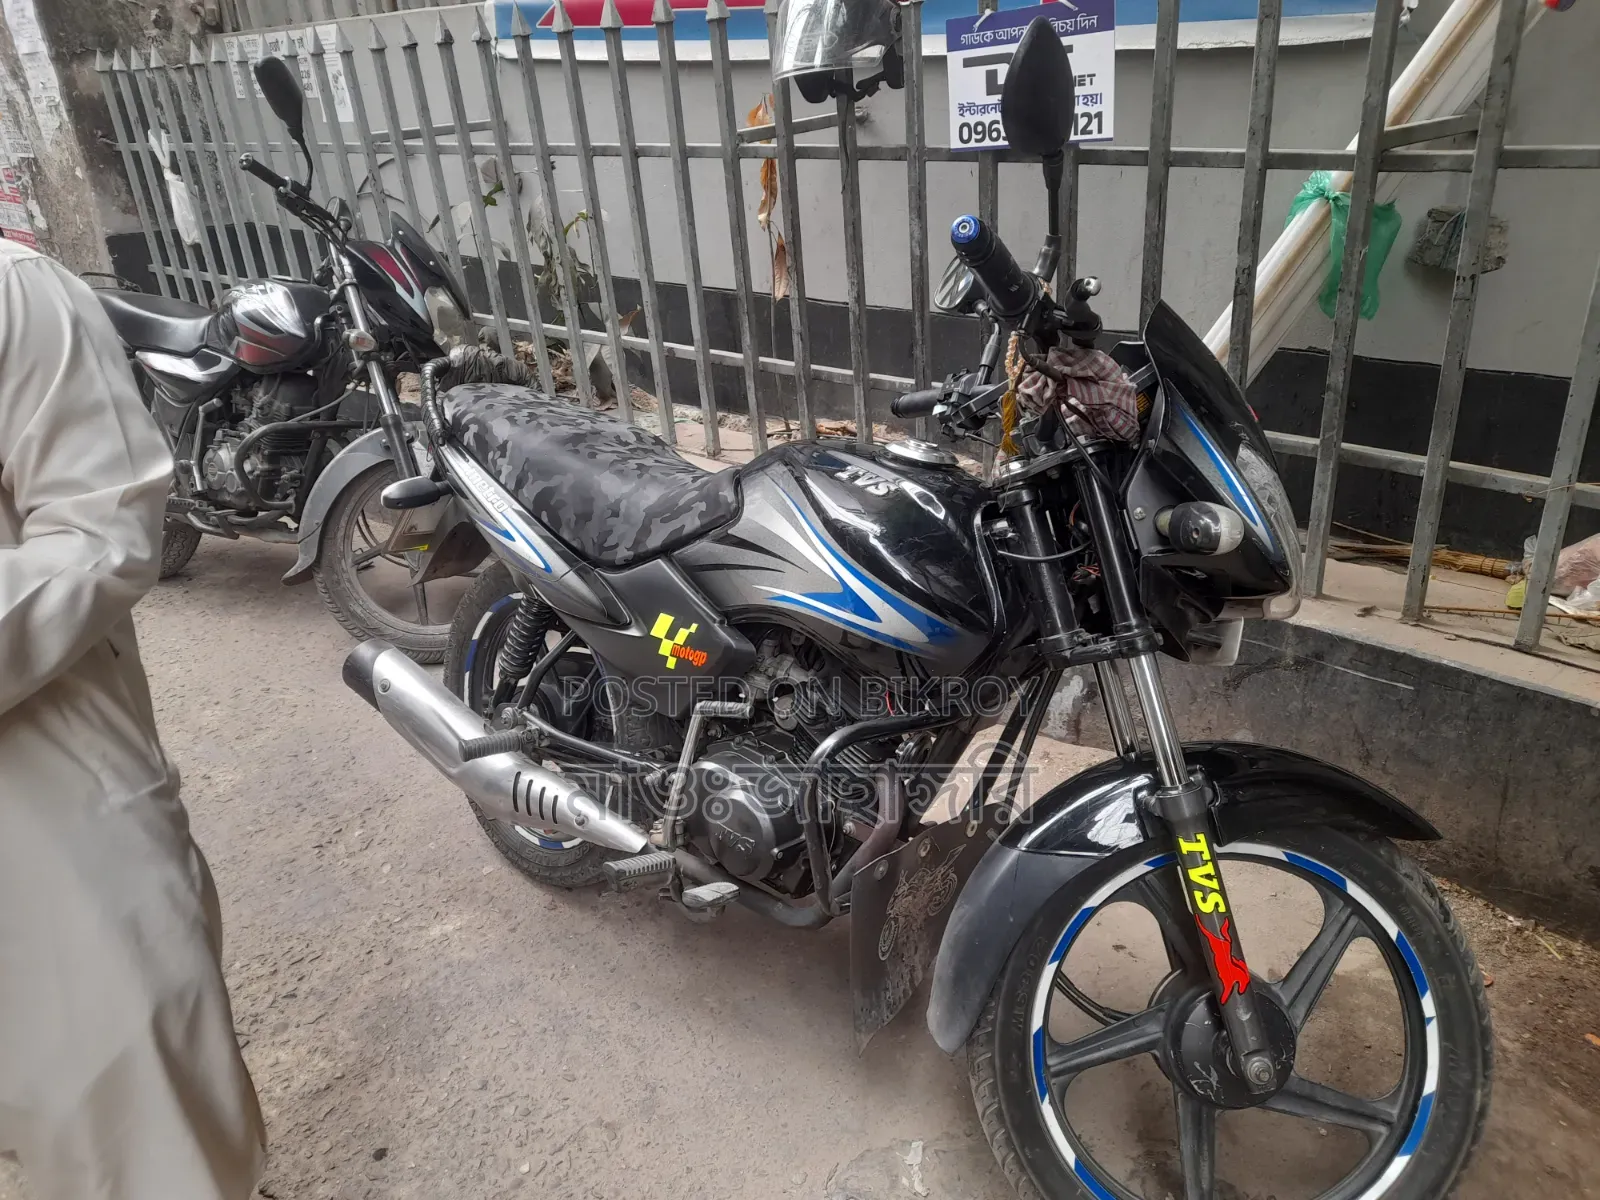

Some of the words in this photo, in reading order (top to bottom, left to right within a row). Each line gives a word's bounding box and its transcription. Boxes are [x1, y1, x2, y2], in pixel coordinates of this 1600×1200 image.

[1076, 13, 1098, 30] দিন
[834, 465, 901, 496] TVS
[671, 643, 708, 667] motogp
[1177, 832, 1227, 914] TVS
